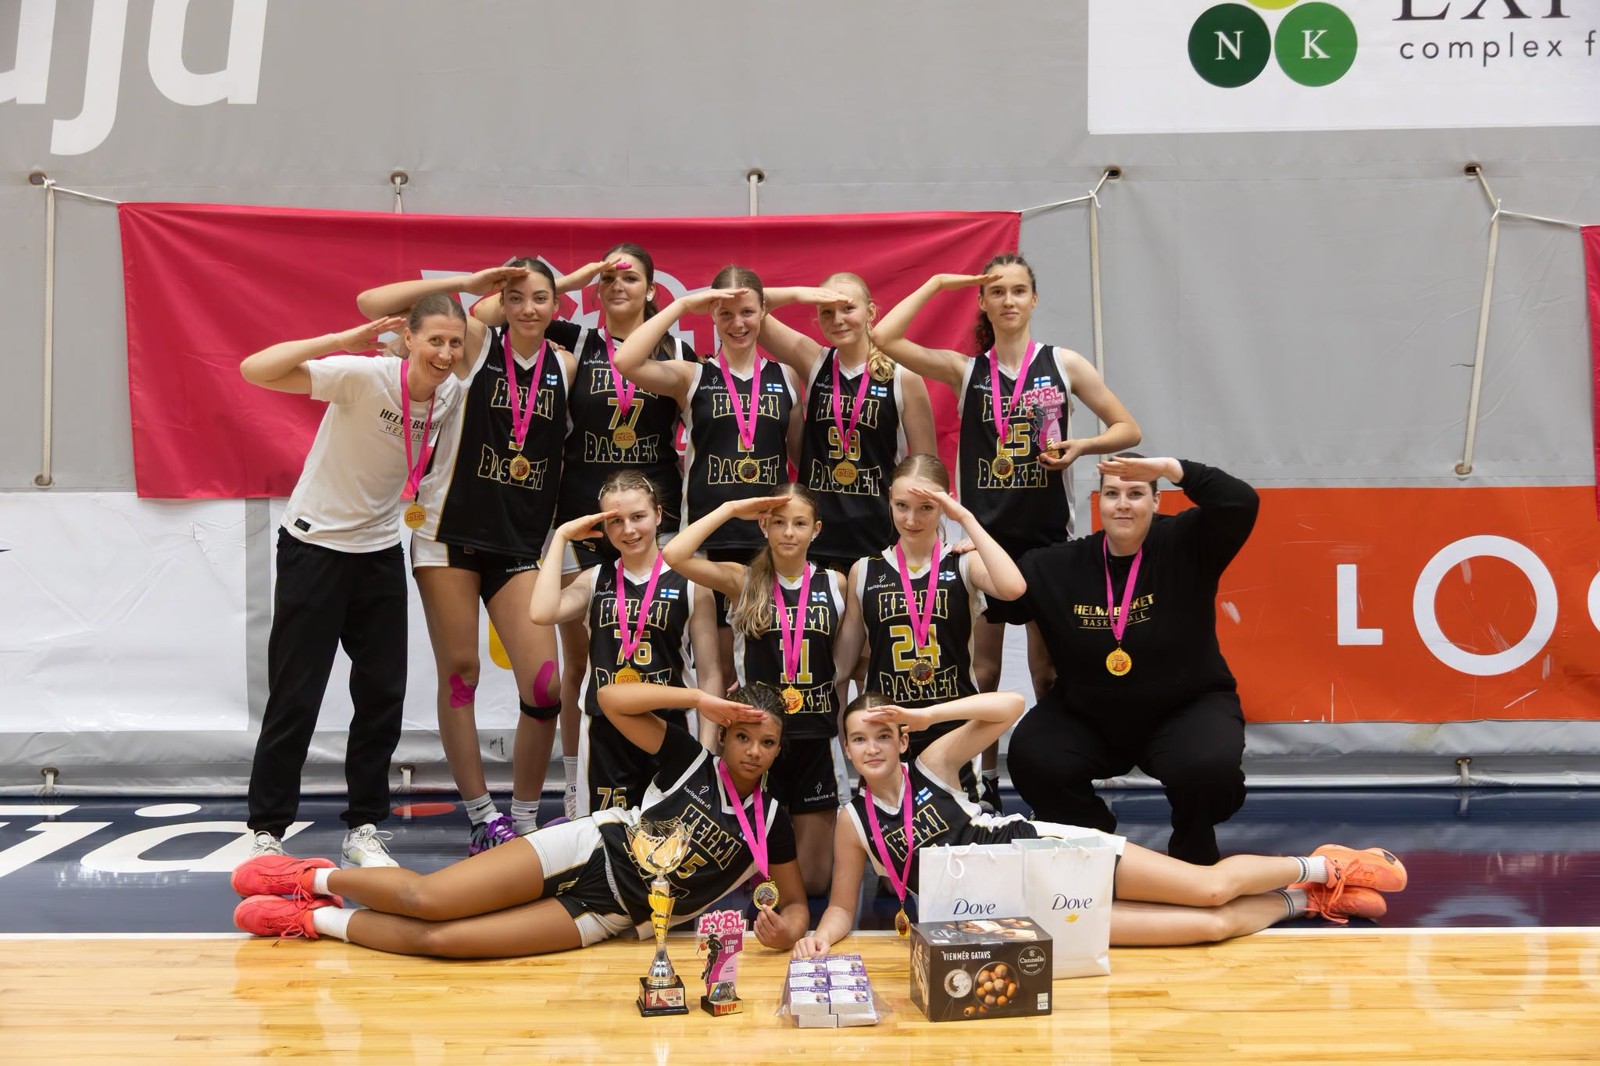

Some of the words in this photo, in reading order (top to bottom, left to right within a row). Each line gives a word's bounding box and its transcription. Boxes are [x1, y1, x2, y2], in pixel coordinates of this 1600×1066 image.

[1213, 30, 1244, 60] N
[1300, 29, 1331, 59] K
[1399, 32, 1563, 67] complex
[607, 397, 645, 430] 77
[828, 426, 861, 461] 98
[996, 422, 1031, 456] 25
[478, 444, 548, 490] BASET
[1074, 604, 1110, 616] HELM
[1336, 534, 1600, 677] LO
[889, 622, 941, 672] 24
[597, 787, 628, 811] 76
[953, 898, 996, 915] Dove
[1052, 893, 1093, 910] Dove
[701, 911, 745, 933] EYBL
[970, 950, 992, 960] GATAVS
[721, 1003, 737, 1012] MVP
